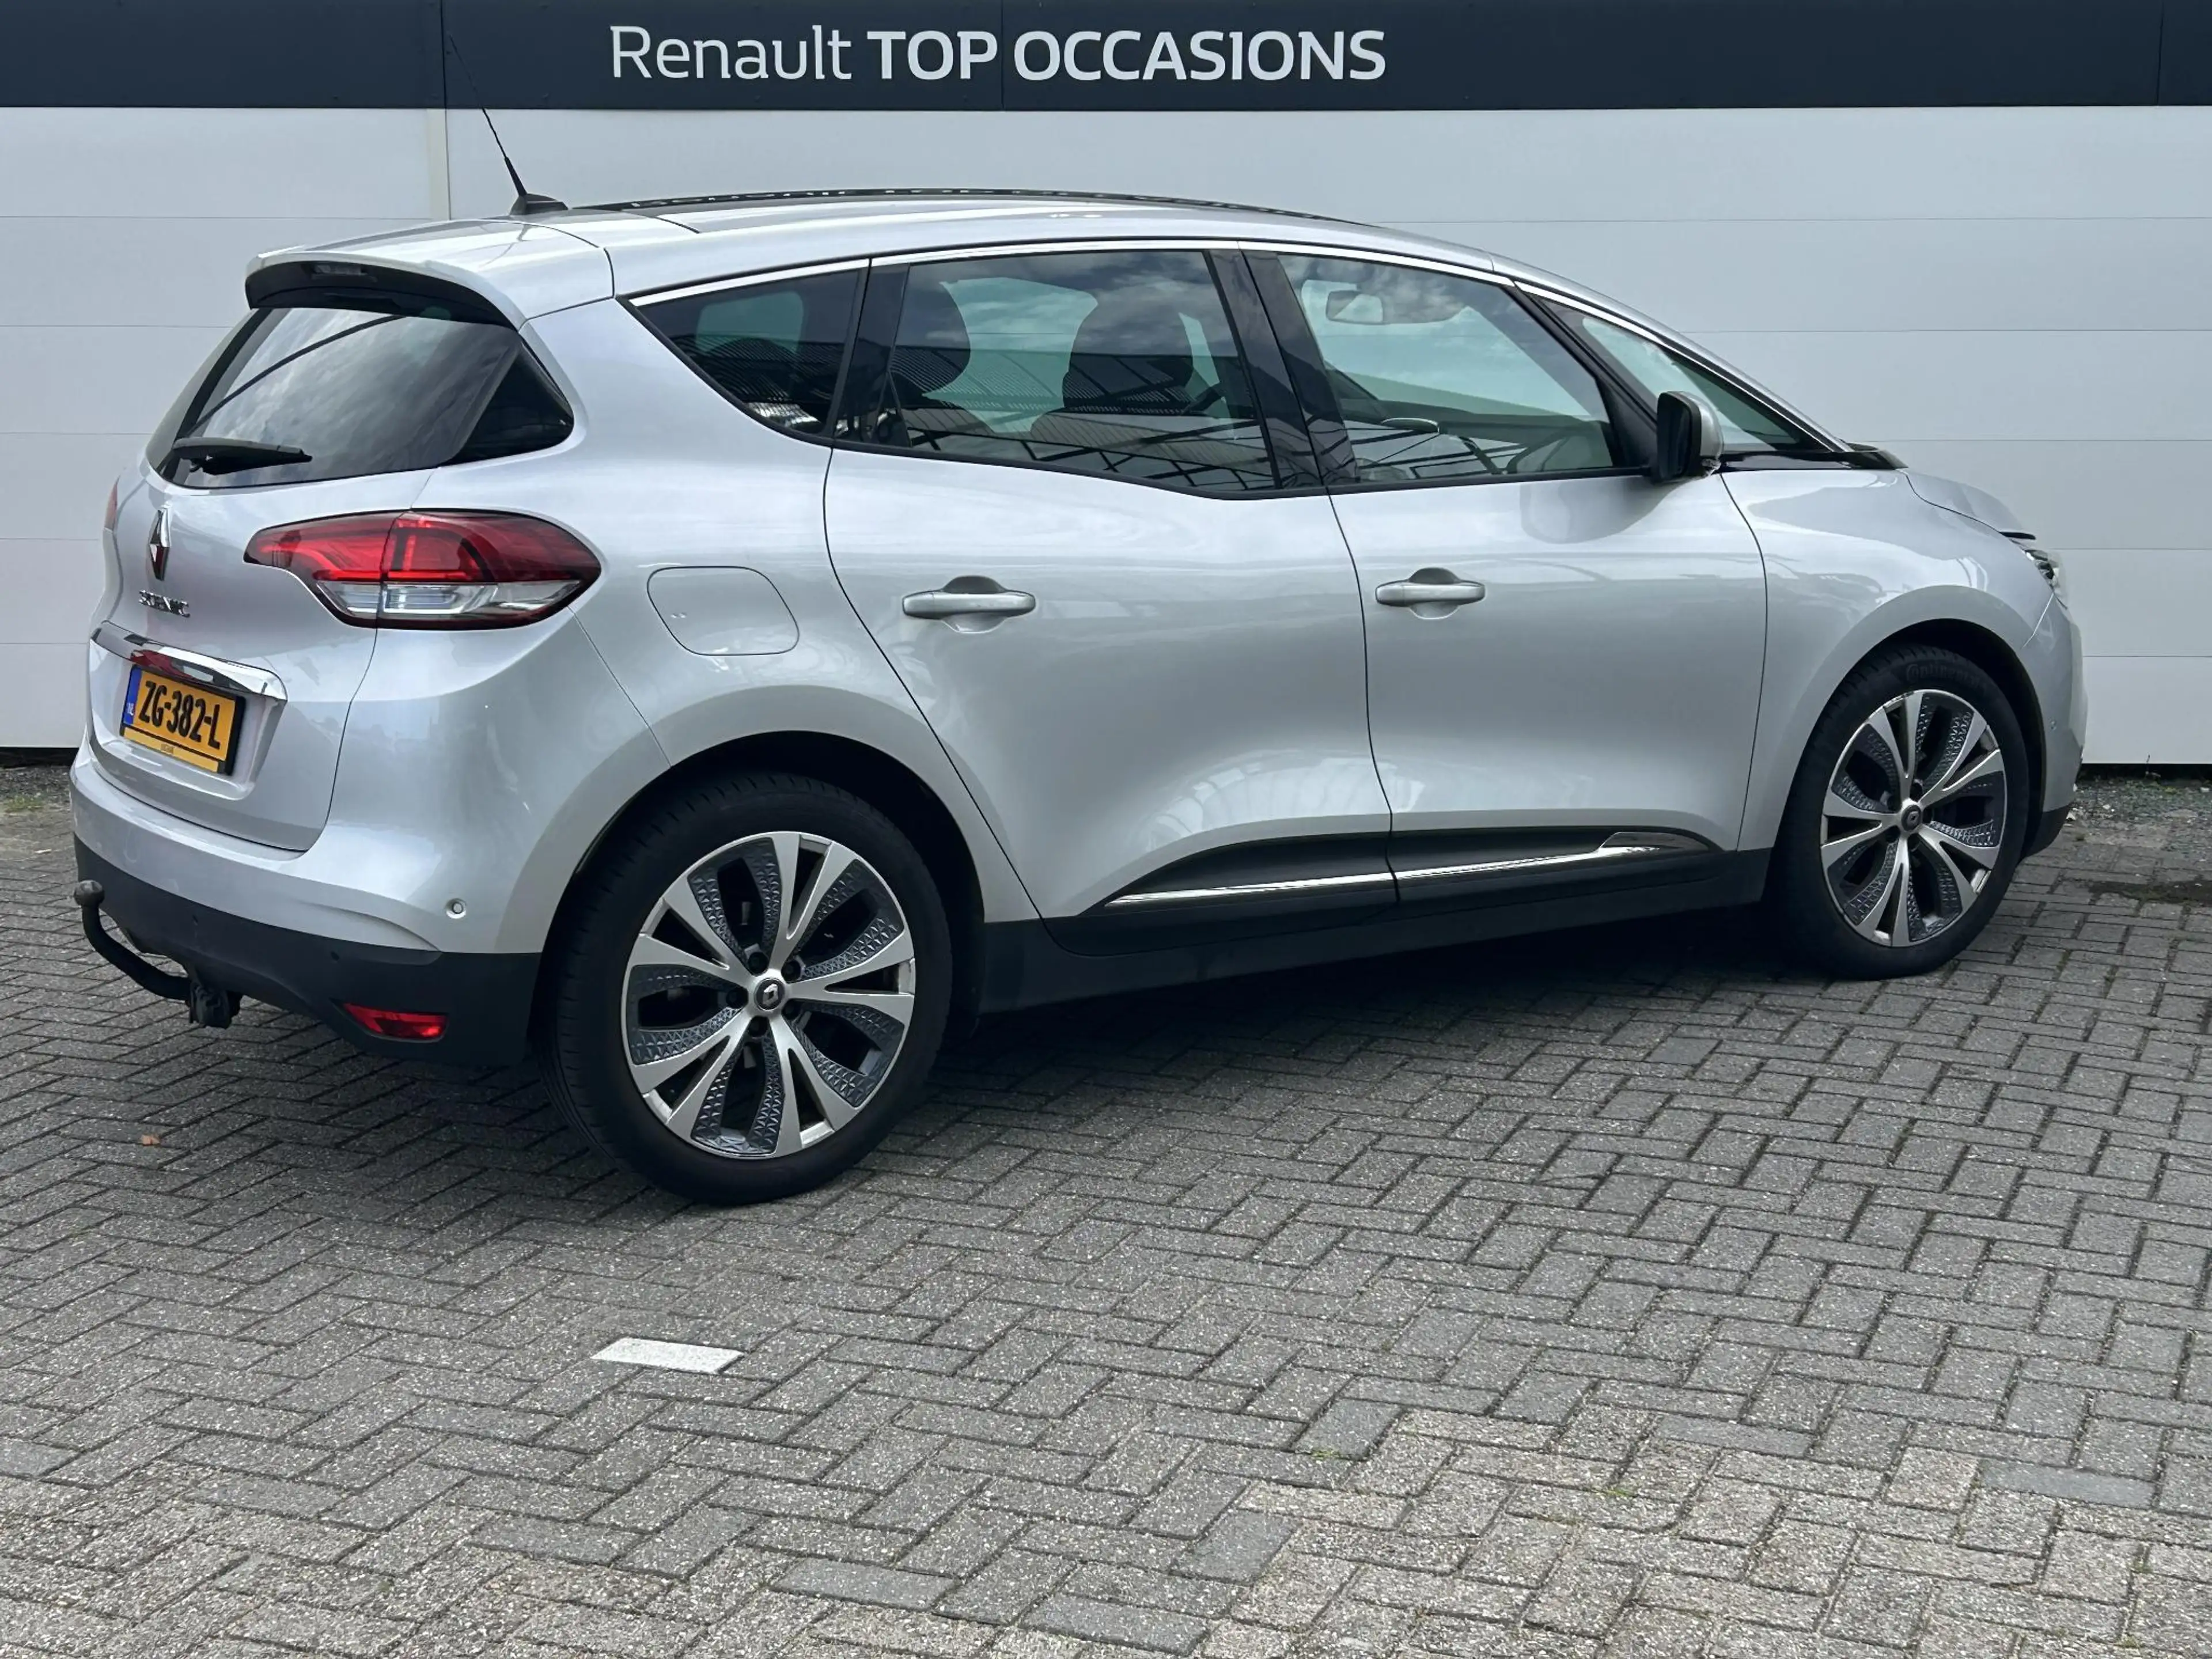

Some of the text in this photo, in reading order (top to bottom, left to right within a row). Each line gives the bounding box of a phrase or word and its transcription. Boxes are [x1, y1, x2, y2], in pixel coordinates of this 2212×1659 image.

[610, 25, 1385, 81] Renault TOP OCCASIONS
[138, 680, 221, 750] ZG-382-L
